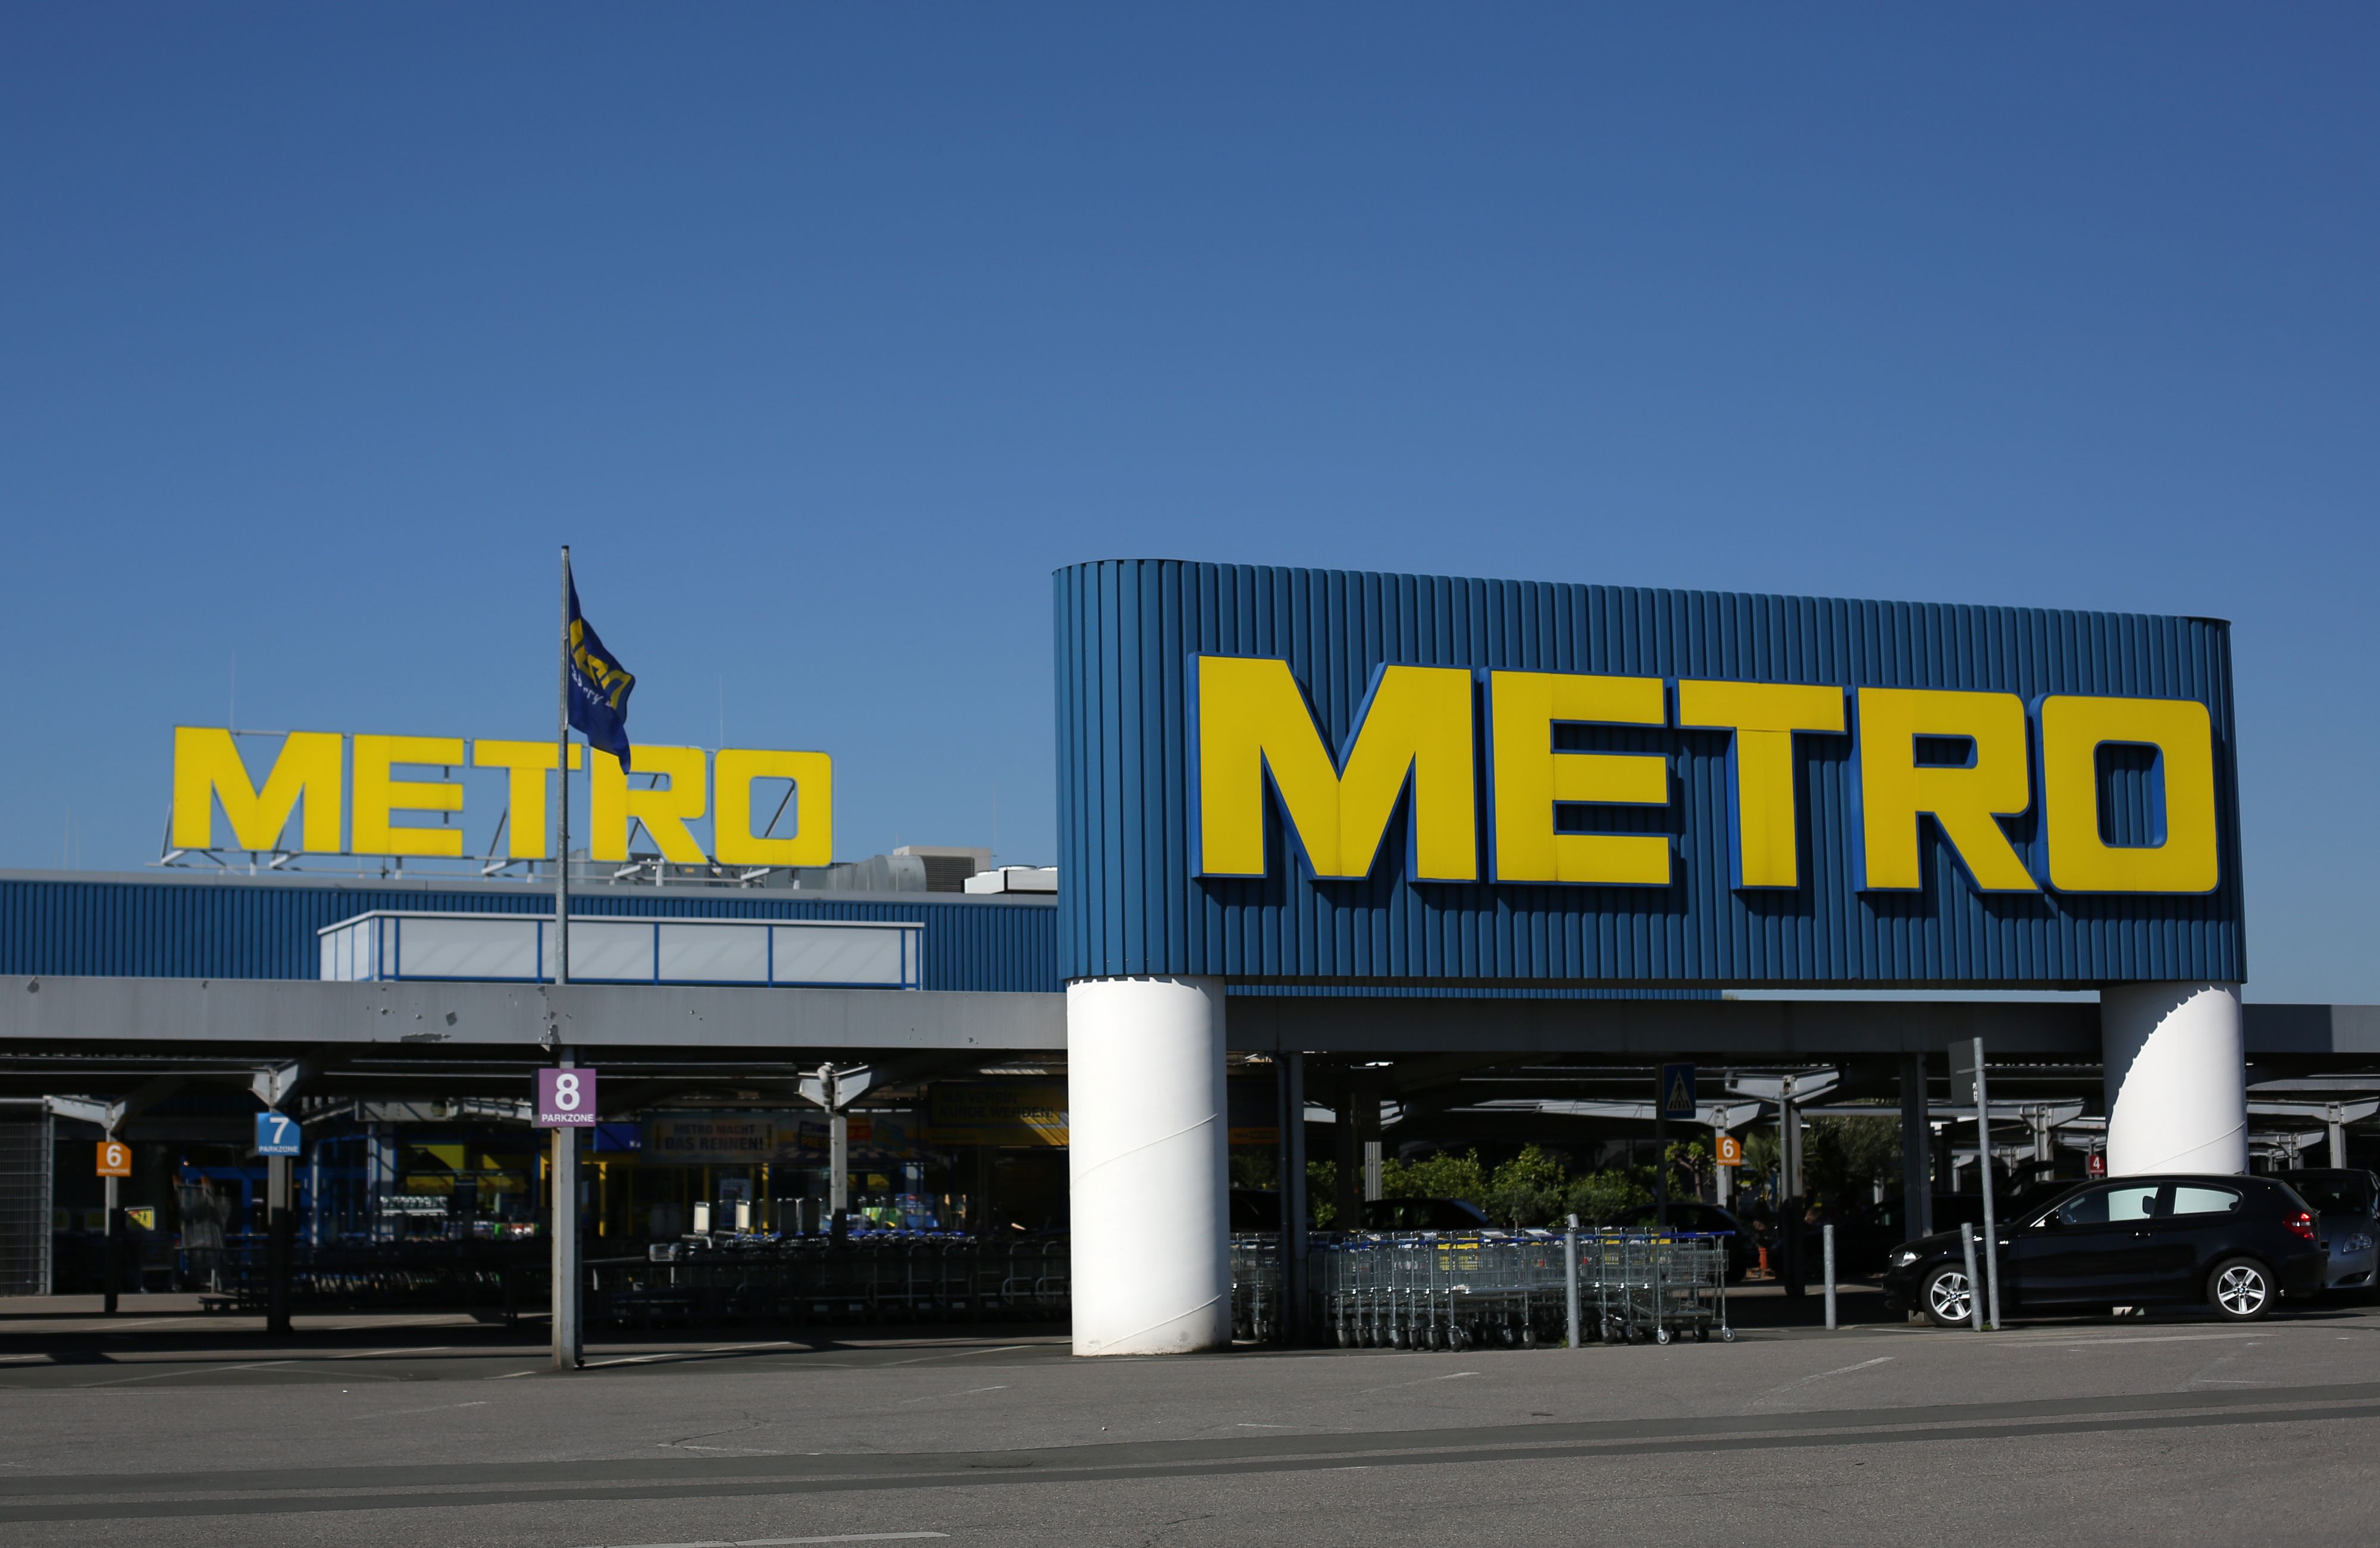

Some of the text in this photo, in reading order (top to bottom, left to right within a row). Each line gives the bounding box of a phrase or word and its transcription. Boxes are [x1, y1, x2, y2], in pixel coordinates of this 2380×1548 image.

[1197, 655, 2219, 893] METRO
[173, 726, 832, 867] METRO
[554, 1073, 581, 1111] 8
[969, 1091, 1019, 1104] VEREIN
[541, 1114, 594, 1122] PARKZONE
[938, 1106, 1054, 1118] KUNDE WERDEN!
[269, 1117, 290, 1144] 7
[674, 1124, 756, 1134] METRO MACHT
[665, 1137, 764, 1150] DAS RENNEN!
[1723, 1140, 1734, 1158] 6
[106, 1144, 123, 1168] 6
[2093, 1156, 2100, 1169] 4
